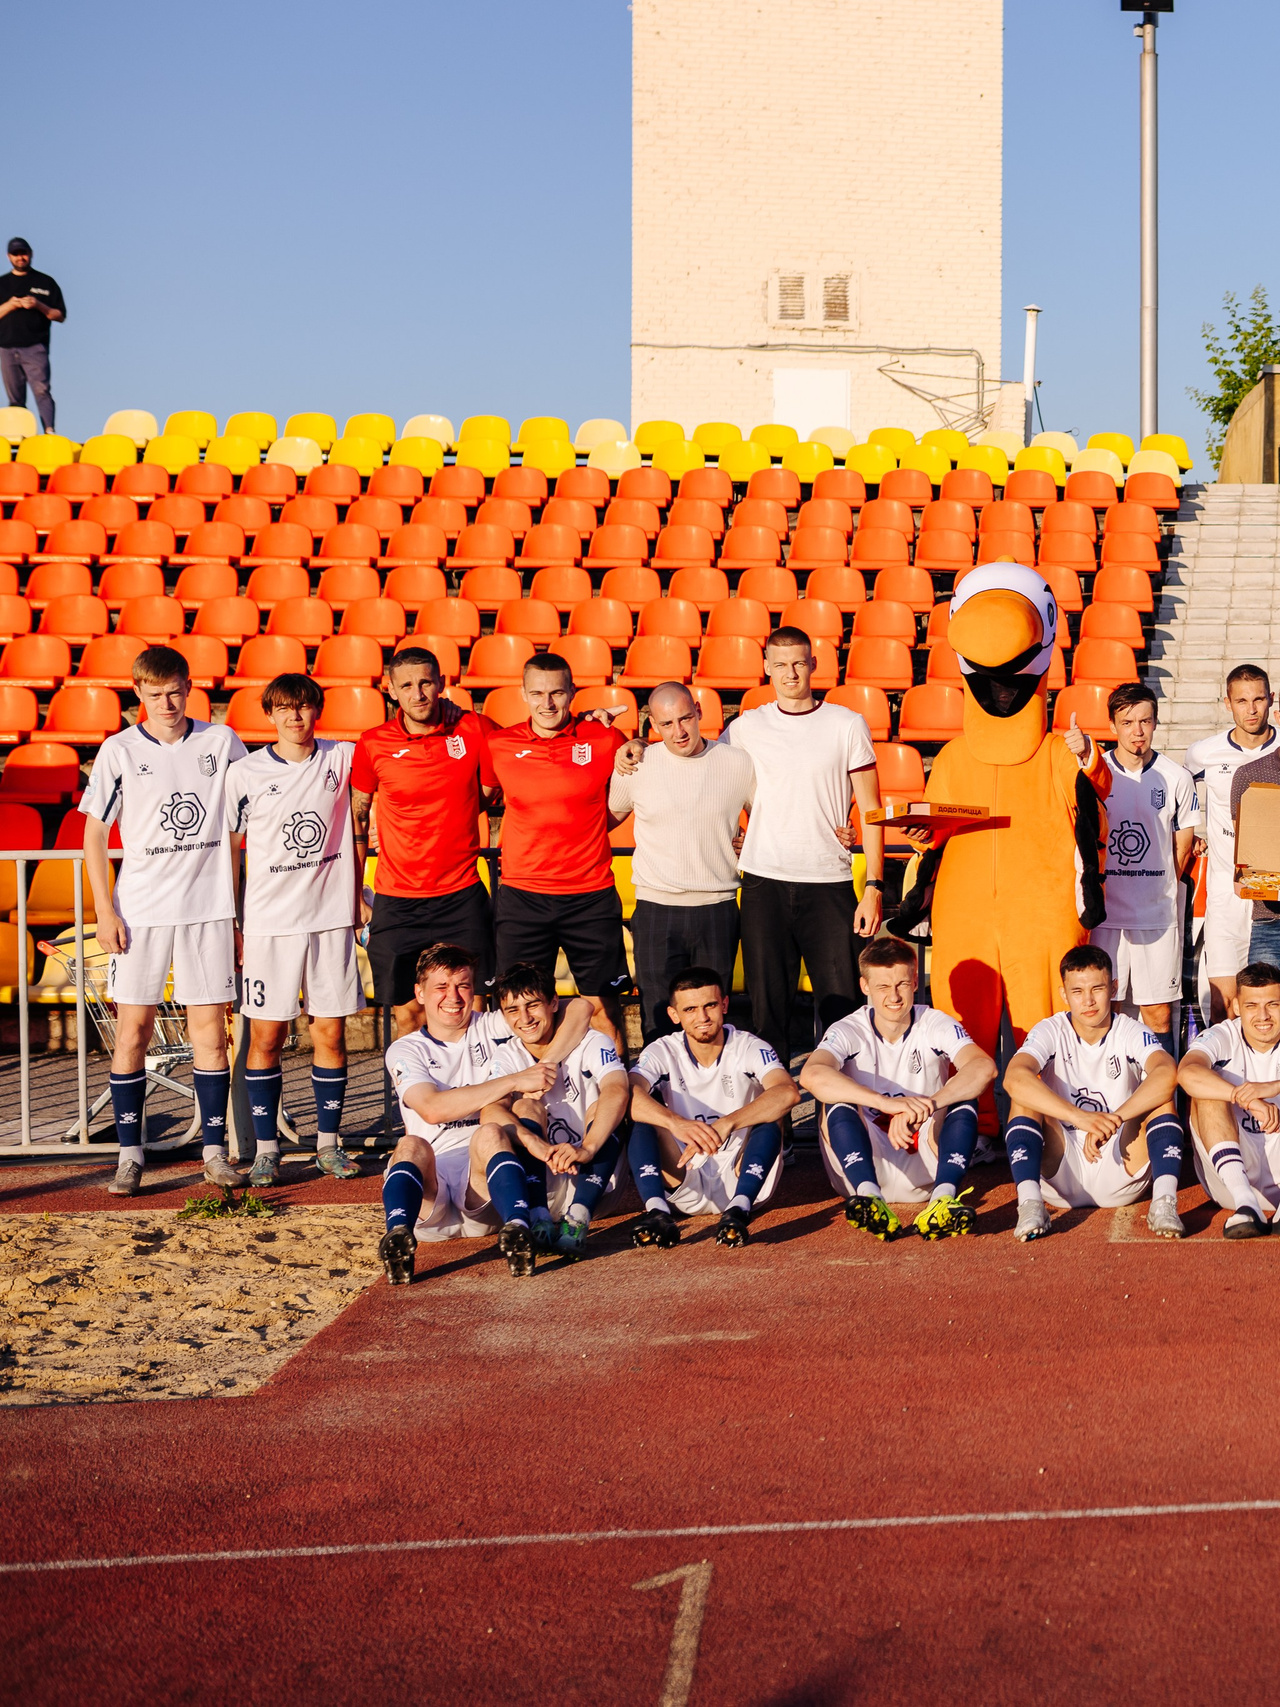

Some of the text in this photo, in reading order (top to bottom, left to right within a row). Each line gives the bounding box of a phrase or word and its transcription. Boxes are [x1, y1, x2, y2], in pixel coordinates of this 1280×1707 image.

[938, 806, 982, 816] ДОДО ПИЦЦА
[244, 977, 266, 1008] 13
